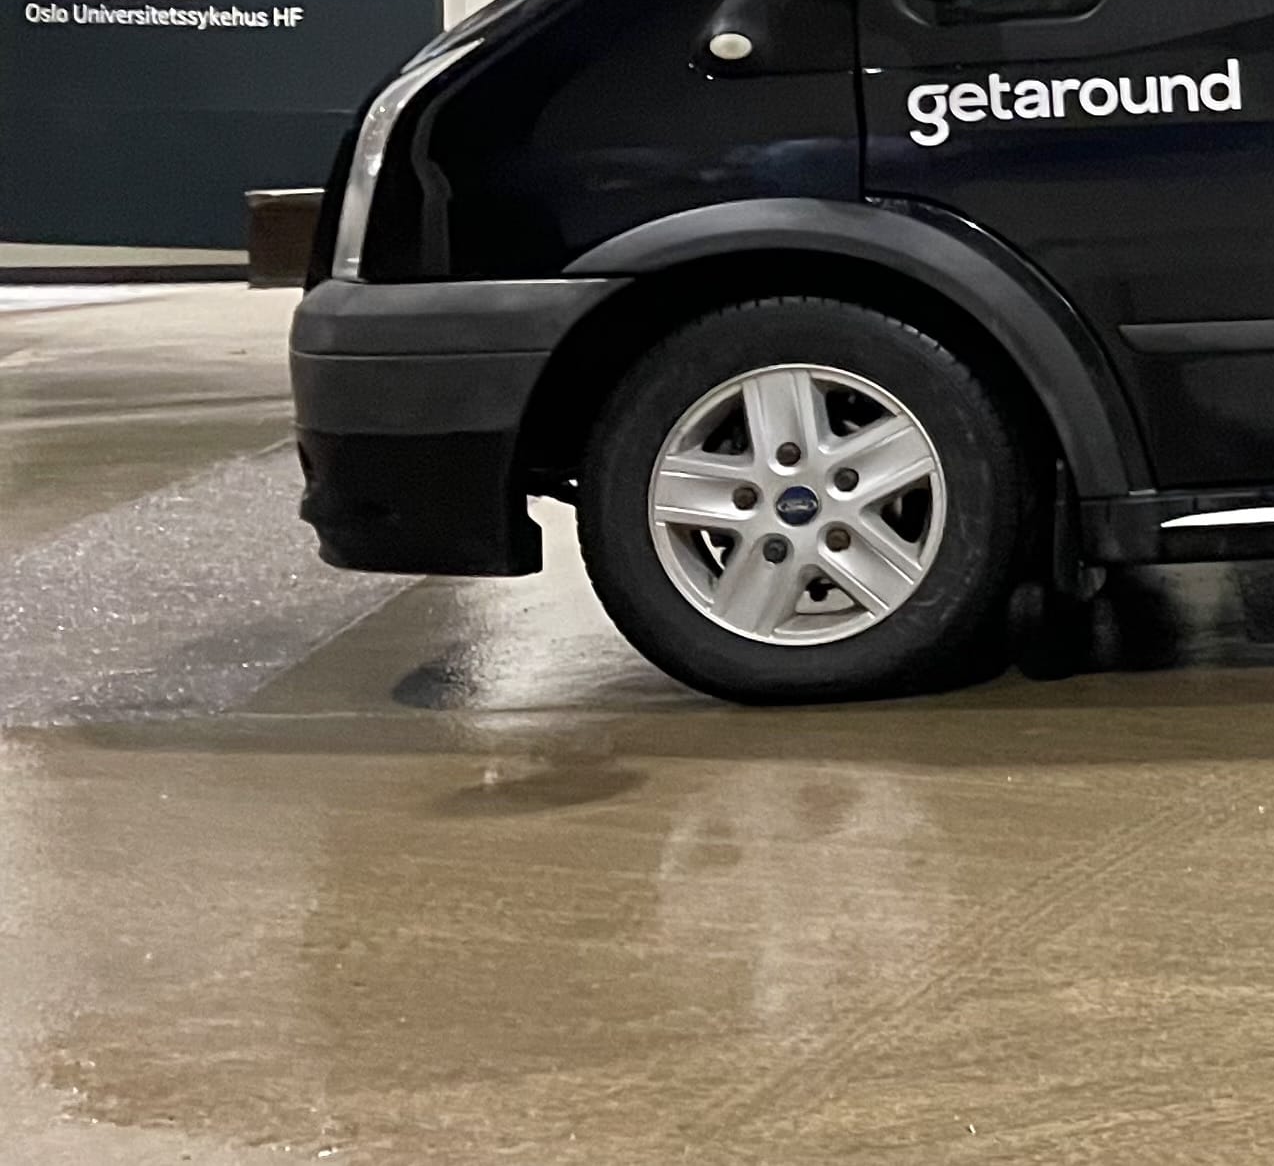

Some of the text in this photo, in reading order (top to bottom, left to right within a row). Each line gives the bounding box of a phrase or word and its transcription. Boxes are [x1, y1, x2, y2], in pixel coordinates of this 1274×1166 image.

[25, 2, 305, 30] Oslo Universitetssykehus HF
[906, 58, 1242, 147] getaround
